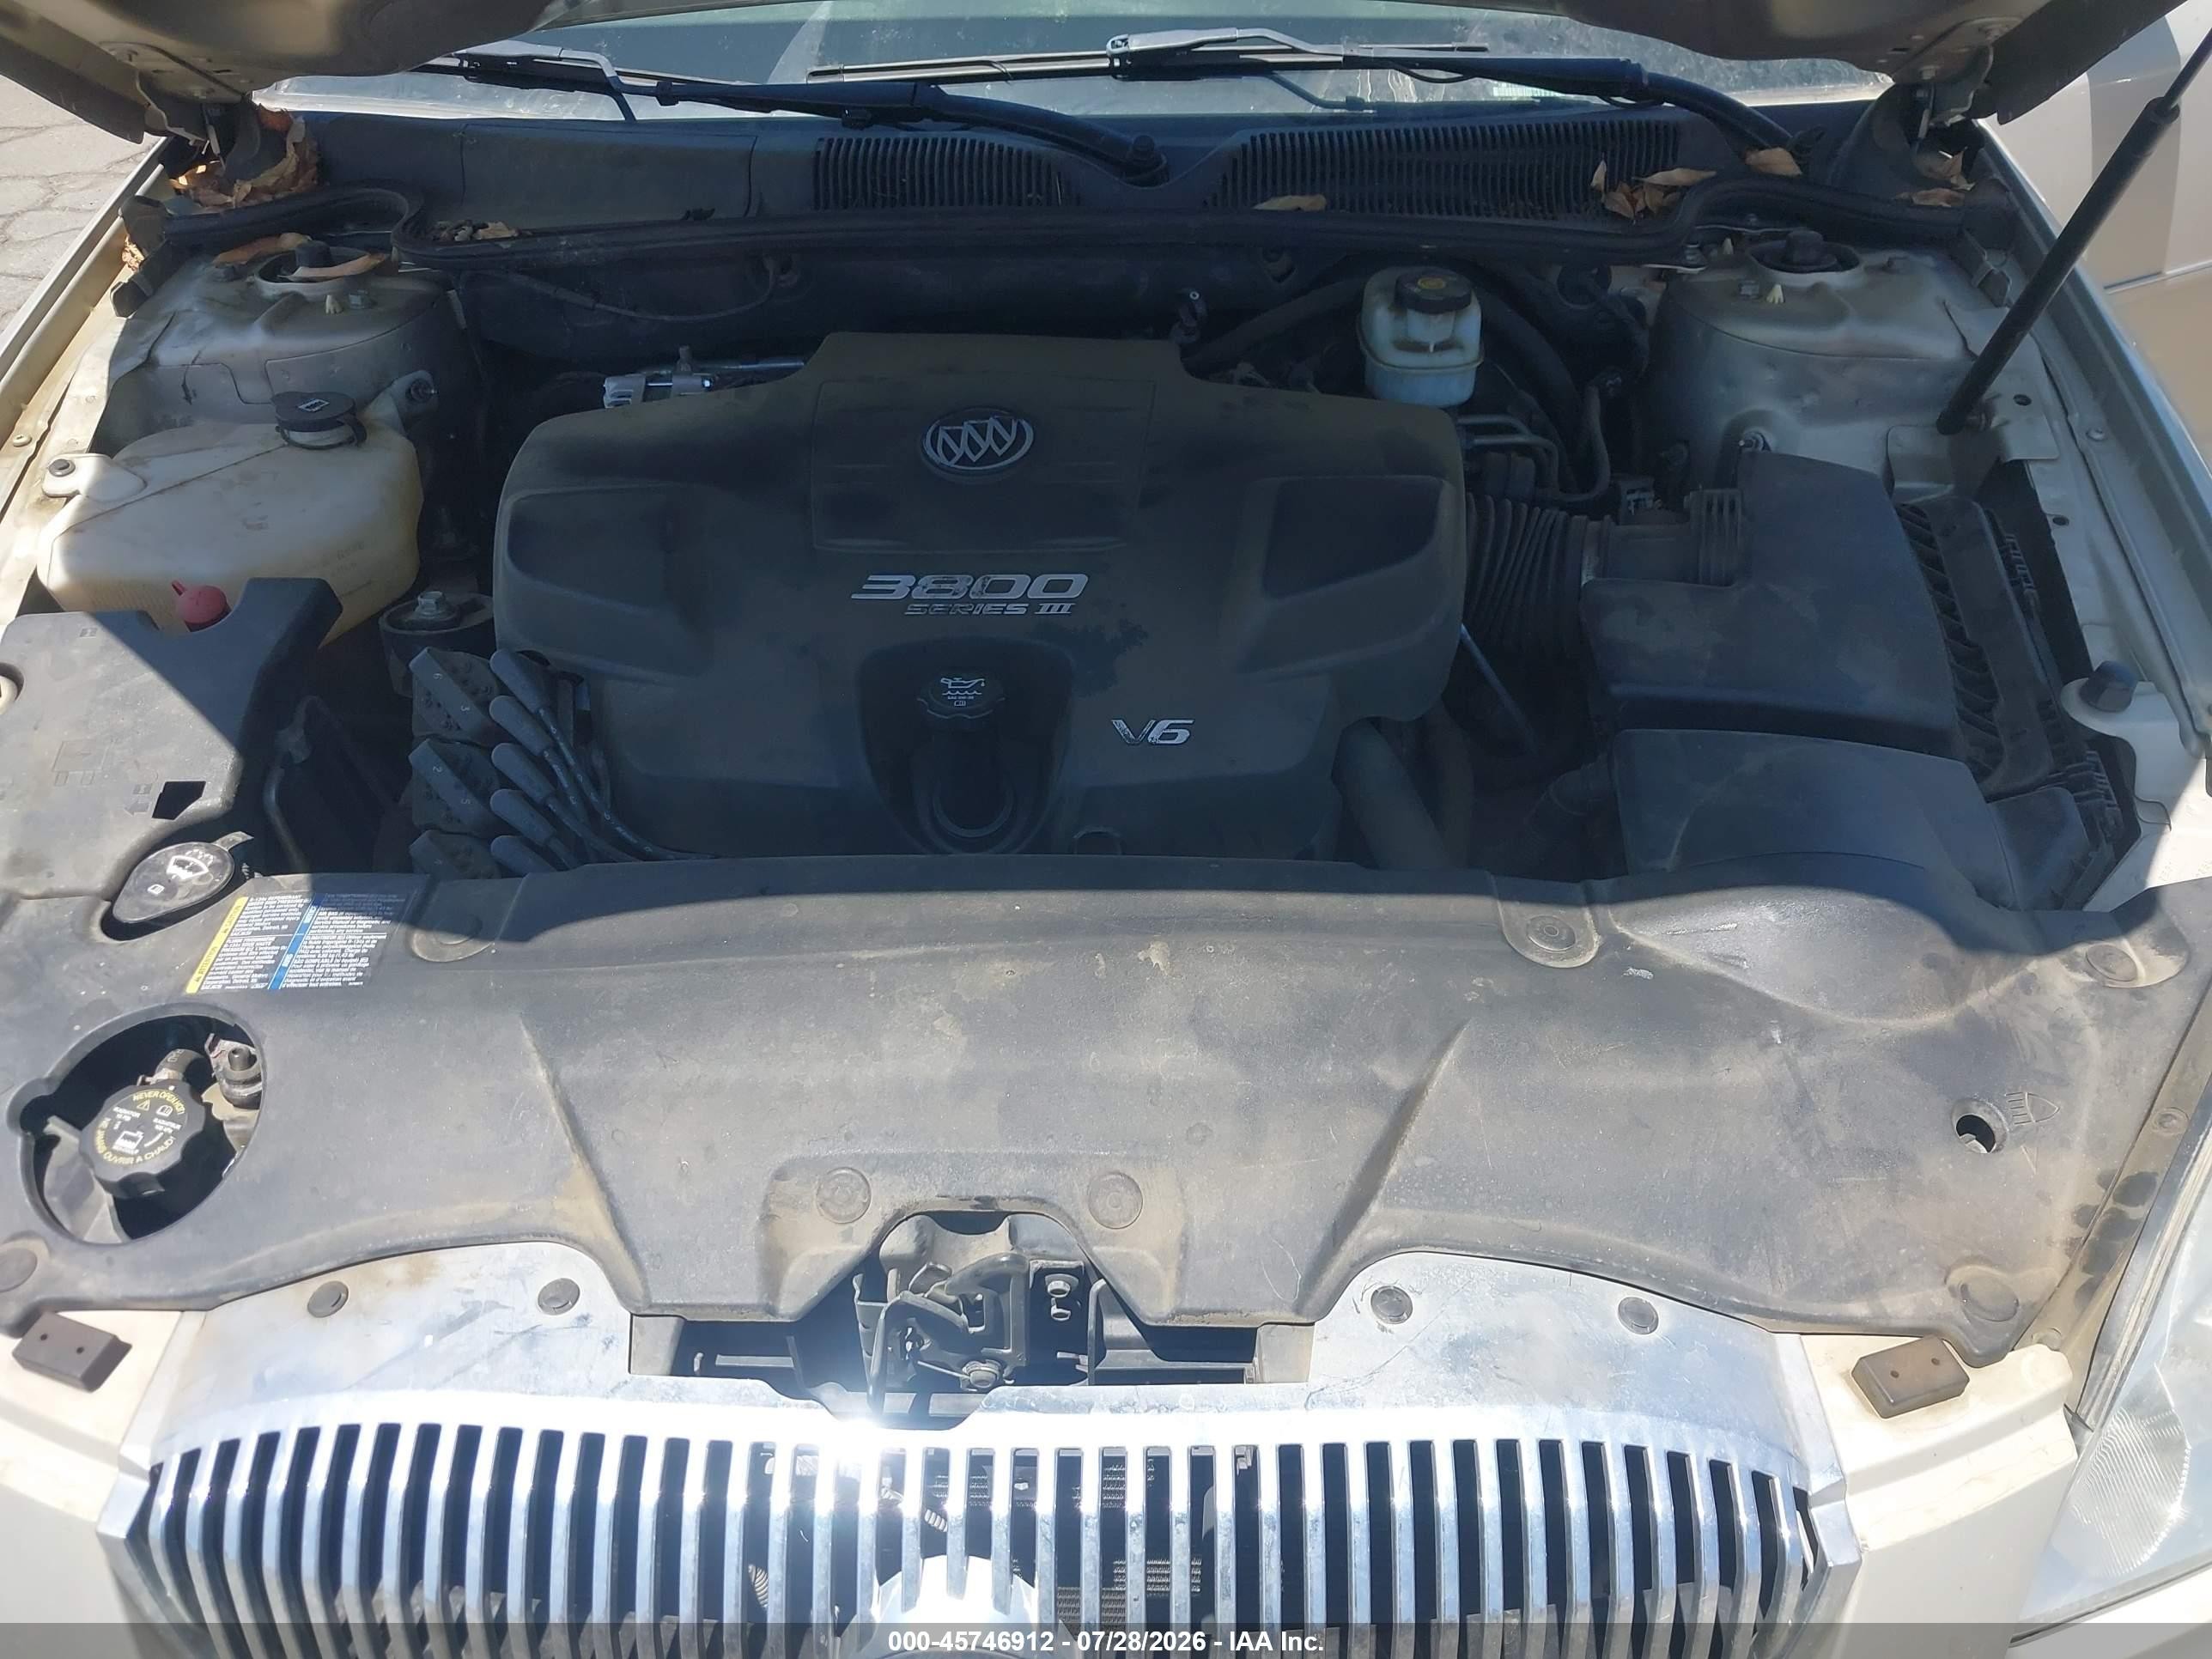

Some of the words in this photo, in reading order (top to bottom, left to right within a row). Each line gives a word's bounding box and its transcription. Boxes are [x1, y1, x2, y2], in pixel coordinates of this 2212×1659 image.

[851, 574, 1089, 599] 3800
[904, 603, 1029, 616] SERIES
[1034, 603, 1076, 615] III
[1110, 720, 1194, 746] V6
[133, 1091, 159, 1102] NEVER
